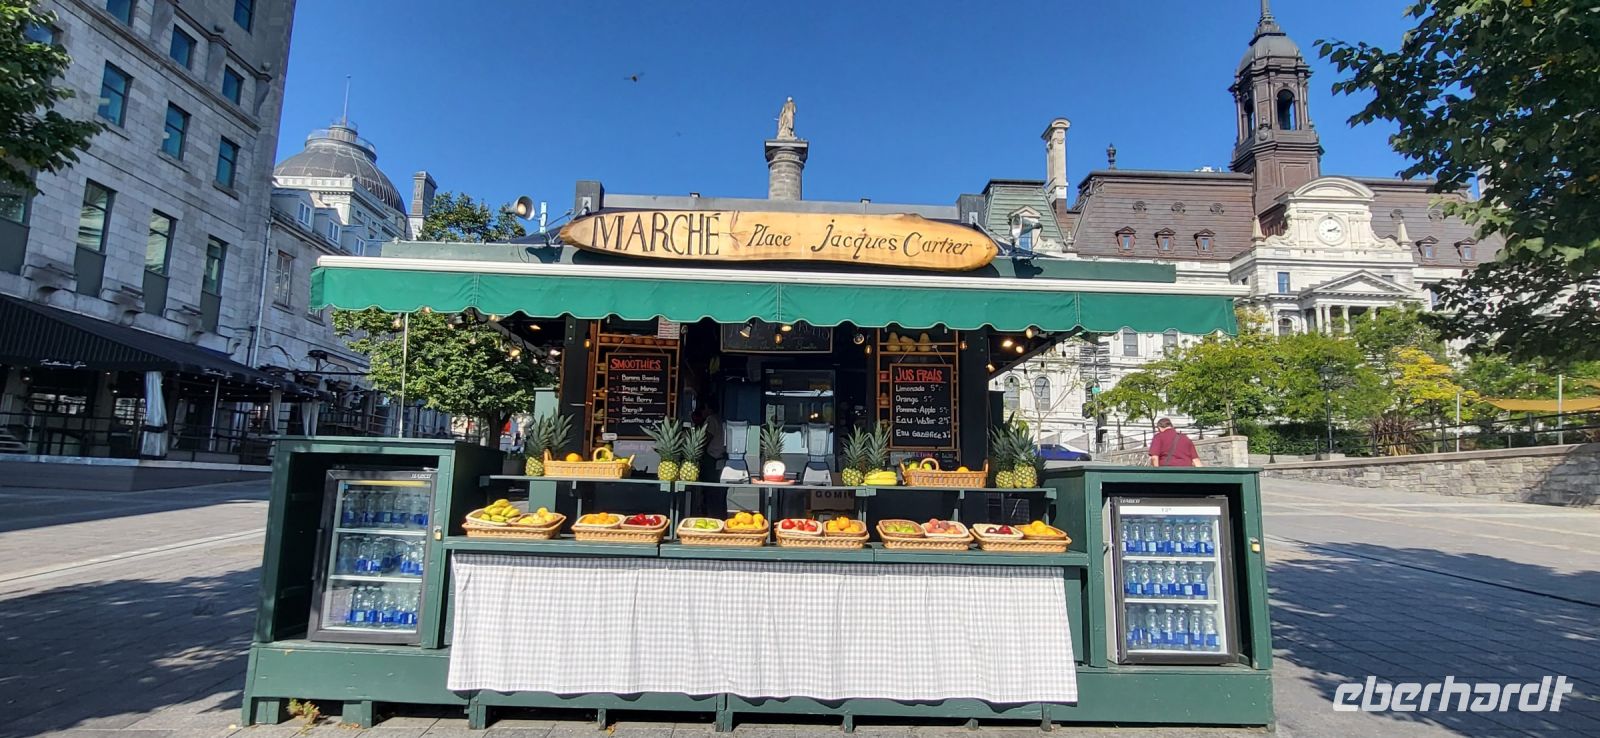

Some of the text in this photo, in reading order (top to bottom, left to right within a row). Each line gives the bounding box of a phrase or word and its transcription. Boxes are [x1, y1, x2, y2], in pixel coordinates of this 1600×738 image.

[591, 212, 973, 259] MARCHÉ Place Jacques Cartier
[895, 367, 914, 381] JUS
